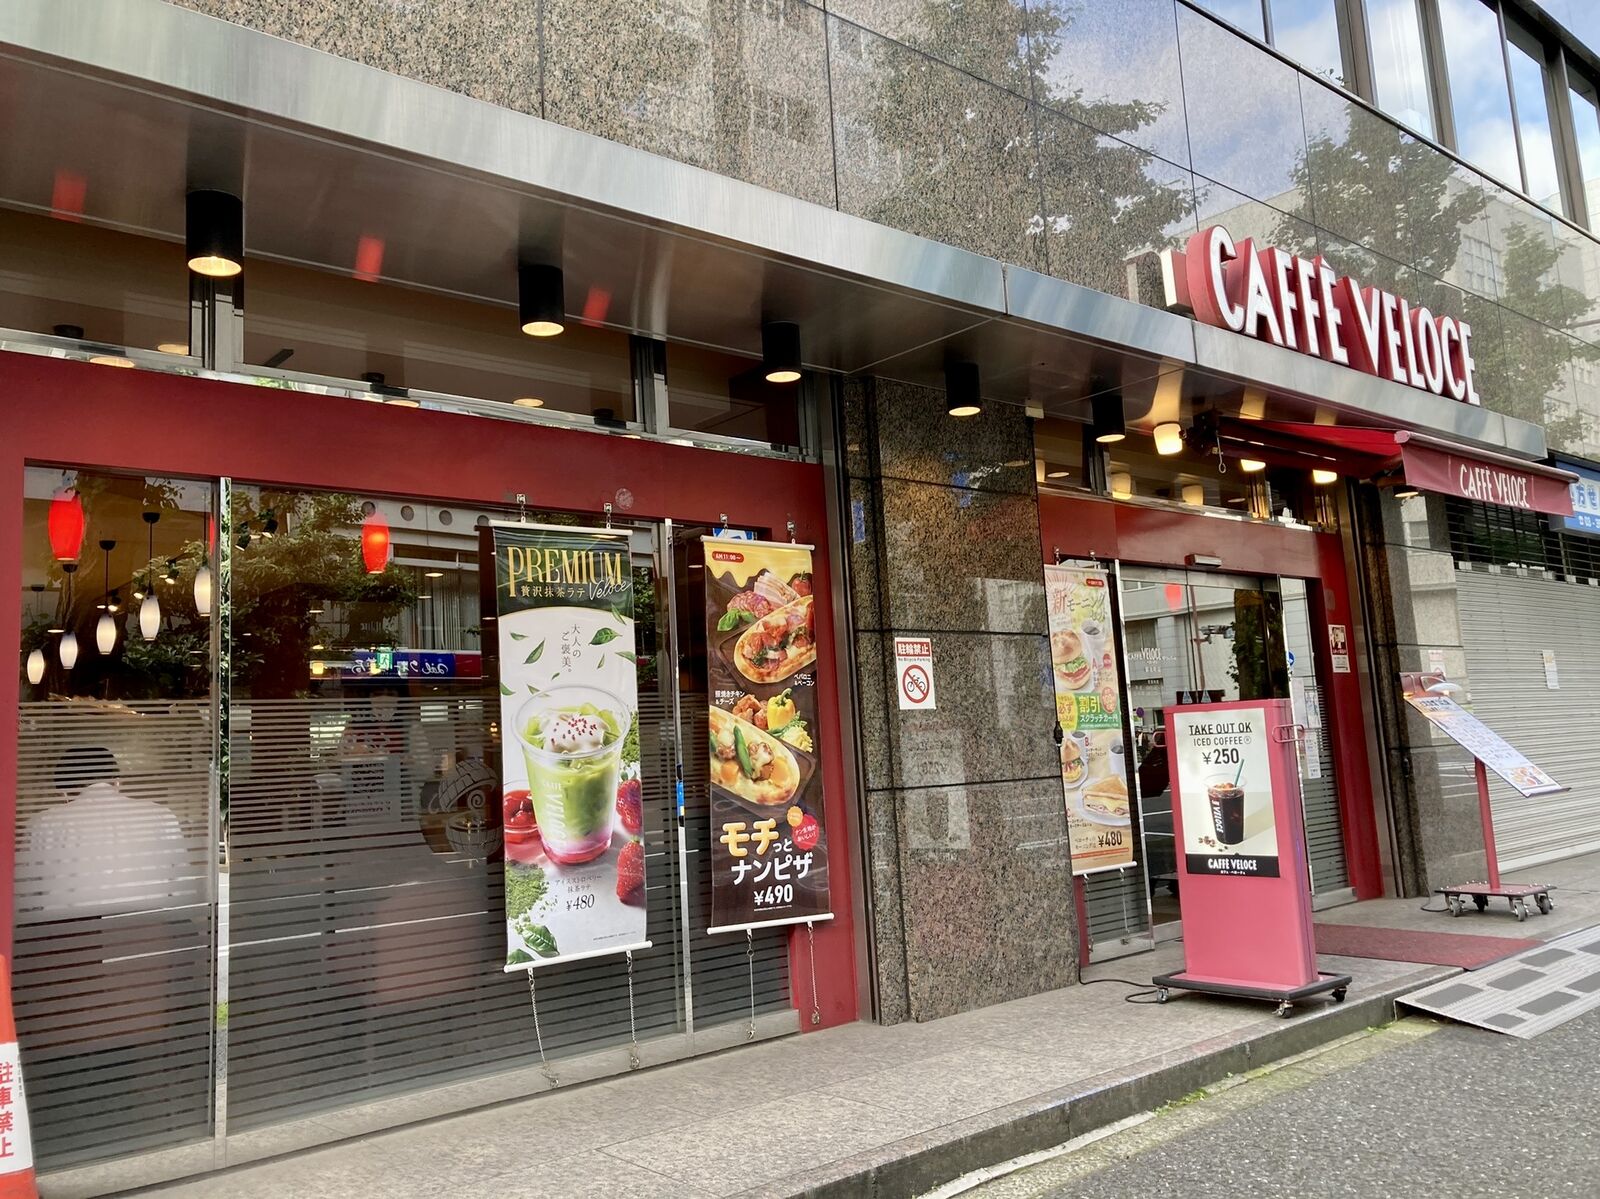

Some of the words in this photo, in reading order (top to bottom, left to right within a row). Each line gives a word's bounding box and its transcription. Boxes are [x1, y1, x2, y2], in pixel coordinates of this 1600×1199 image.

[1348, 276, 1480, 406] VELOCE
[1493, 471, 1530, 508] VELOCE
[507, 546, 622, 597] PREMIUM
[520, 585, 586, 598] 贅沢抹茶ラテ
[572, 624, 582, 659] 大人の
[1189, 724, 1213, 735] TAKE
[1216, 723, 1235, 734] OUT
[1238, 722, 1252, 733] OK
[1194, 737, 1211, 746] ICED
[1214, 736, 1243, 746] COFFEE
[1202, 748, 1240, 764] ¥250
[1097, 830, 1123, 848] ¥480
[730, 851, 814, 886] ナンピザ
[1230, 859, 1257, 871] VELOCE
[566, 893, 596, 911] ¥480
[753, 883, 794, 906] ¥490
